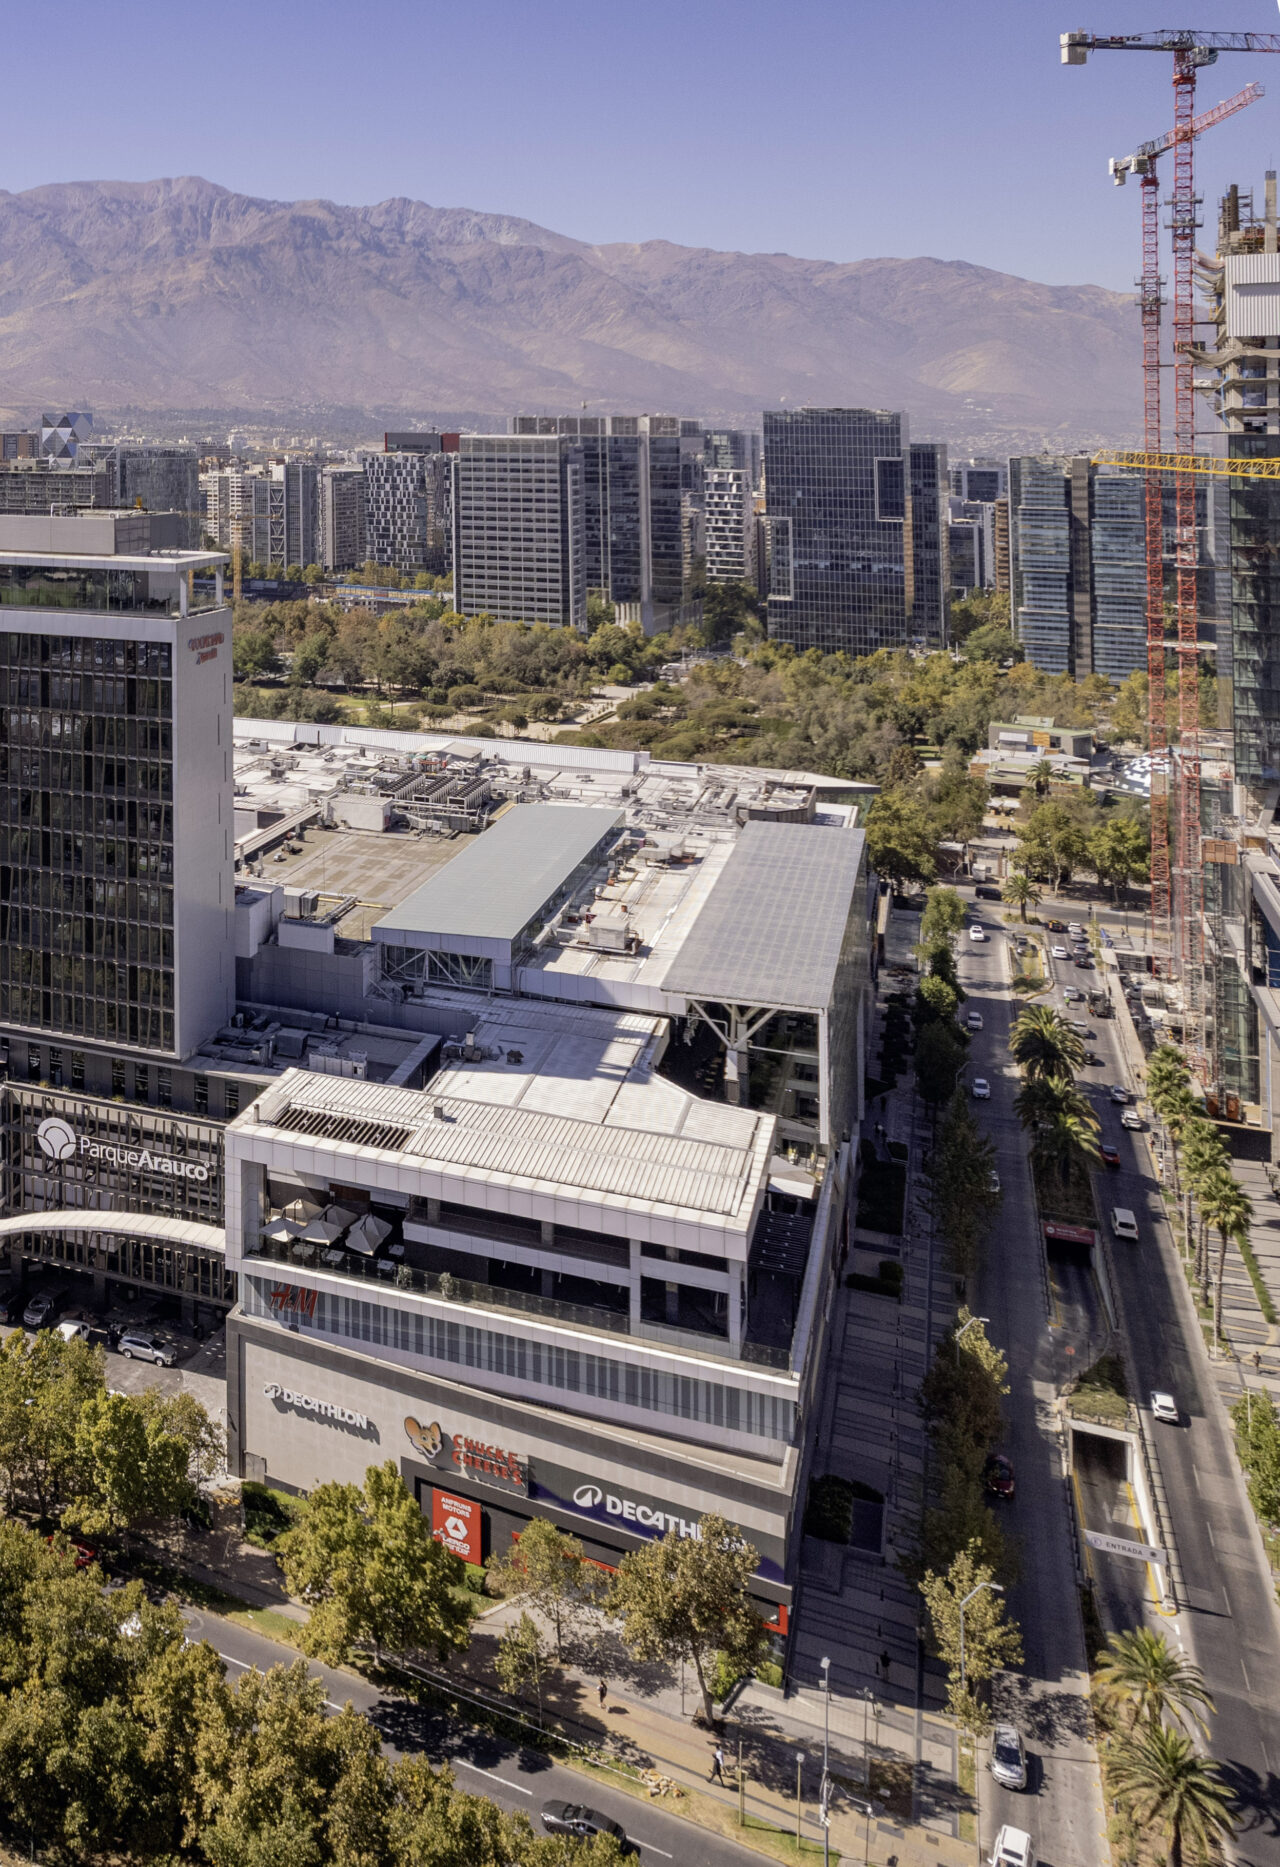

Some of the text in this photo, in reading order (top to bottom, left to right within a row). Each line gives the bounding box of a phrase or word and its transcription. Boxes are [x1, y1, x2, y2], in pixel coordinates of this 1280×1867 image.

[271, 1281, 319, 1319] H&M
[282, 1387, 368, 1430] DECATHLON
[453, 1434, 519, 1469] CHUCK E
[442, 1503, 470, 1519] MOTORS
[1106, 1541, 1143, 1555] ENTRADA
